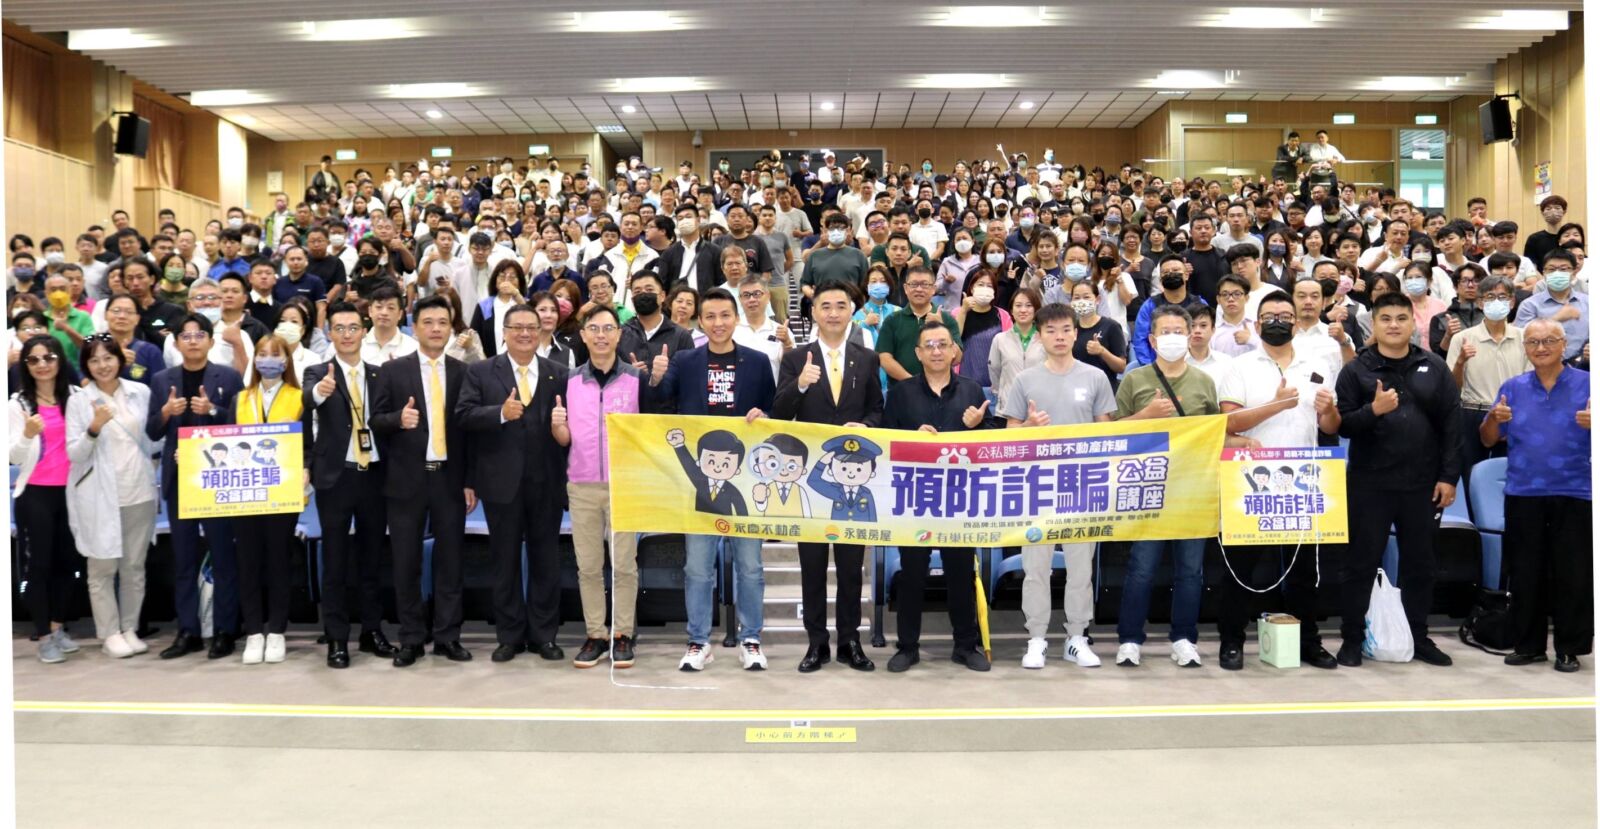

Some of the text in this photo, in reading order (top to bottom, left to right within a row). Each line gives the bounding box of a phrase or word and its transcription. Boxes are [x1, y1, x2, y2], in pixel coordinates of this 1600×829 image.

[977, 439, 1129, 460] 公私聯手 防範不動產詐騙
[201, 466, 281, 489] 預防詐騙
[1116, 455, 1170, 484] 公益
[215, 487, 268, 505] 公益講座
[890, 460, 1110, 518] 預防詐騙
[1115, 484, 1169, 513] 講座
[1243, 493, 1325, 515] 預防詐騙
[734, 522, 801, 538] 永慶不動產
[1046, 524, 1114, 541] 台慶不動產
[1258, 515, 1312, 532] 公益講座
[844, 527, 893, 542] 永義房屋
[935, 532, 1002, 545] 有巢氏房屋
